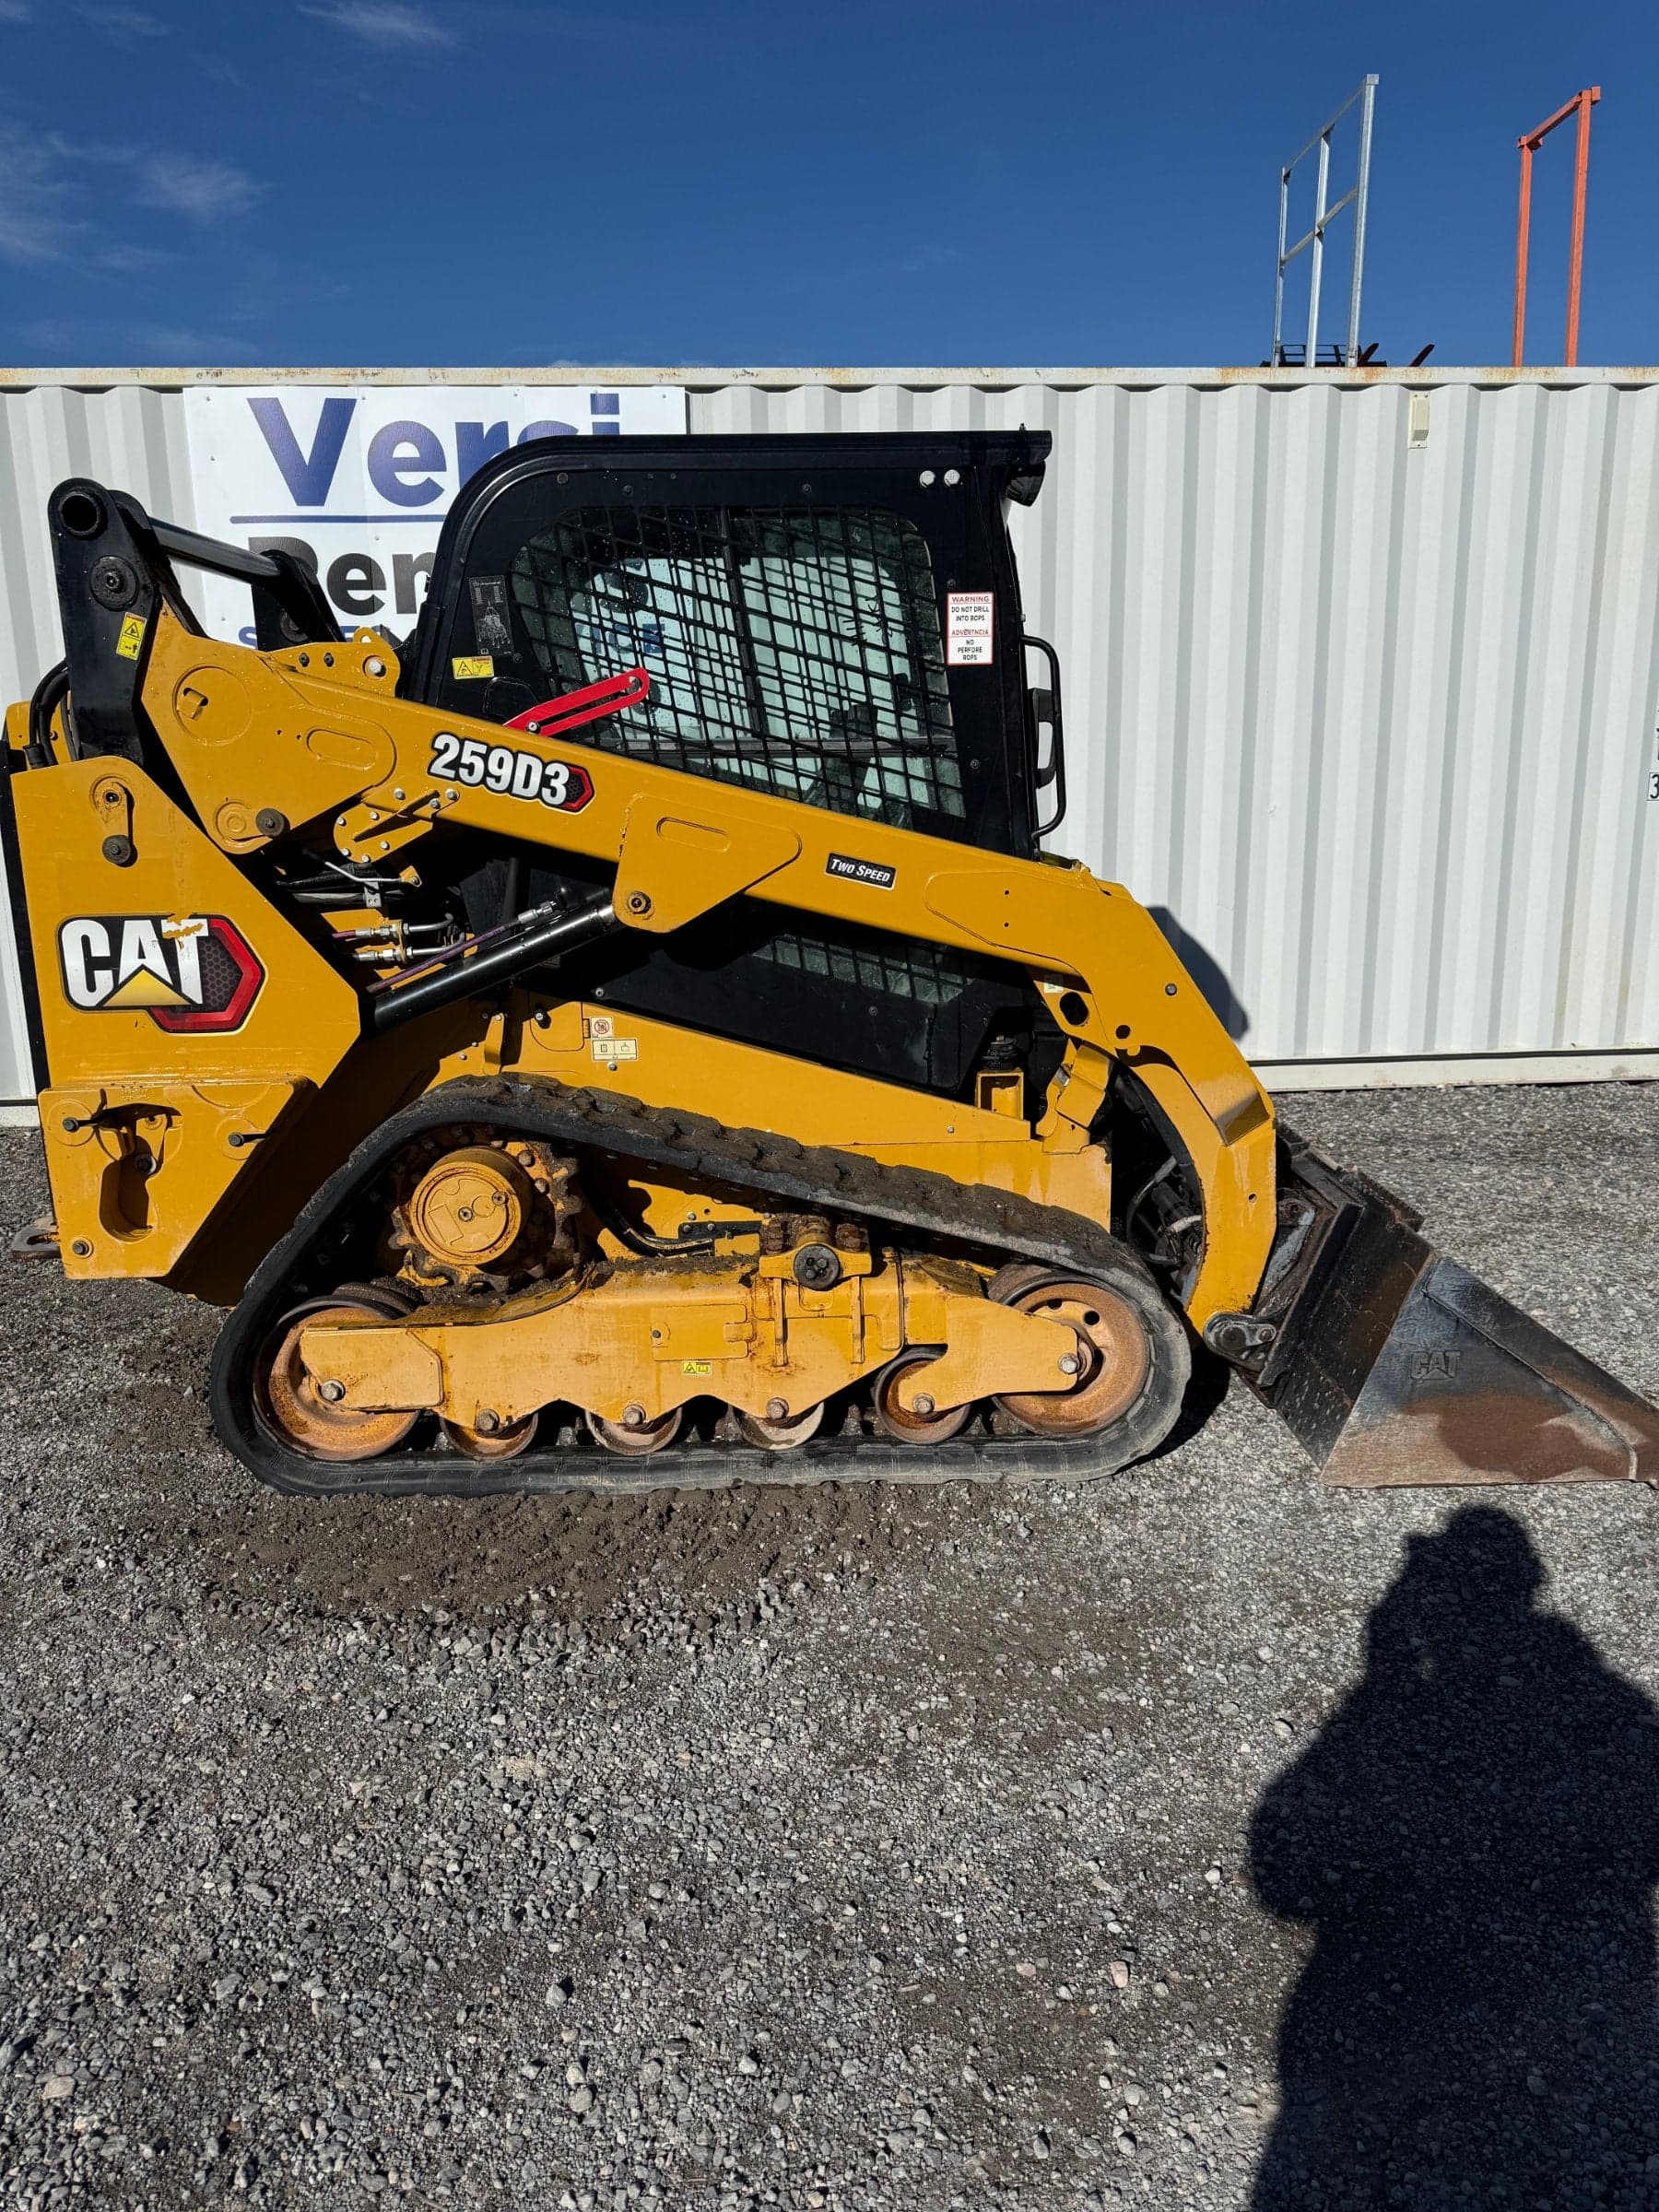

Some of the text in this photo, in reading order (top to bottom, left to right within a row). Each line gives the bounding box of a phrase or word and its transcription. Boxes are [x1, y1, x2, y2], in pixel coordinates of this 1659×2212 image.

[429, 734, 570, 806] 259D3
[61, 918, 208, 1006] CAT
[1410, 1351, 1461, 1380] CAT
